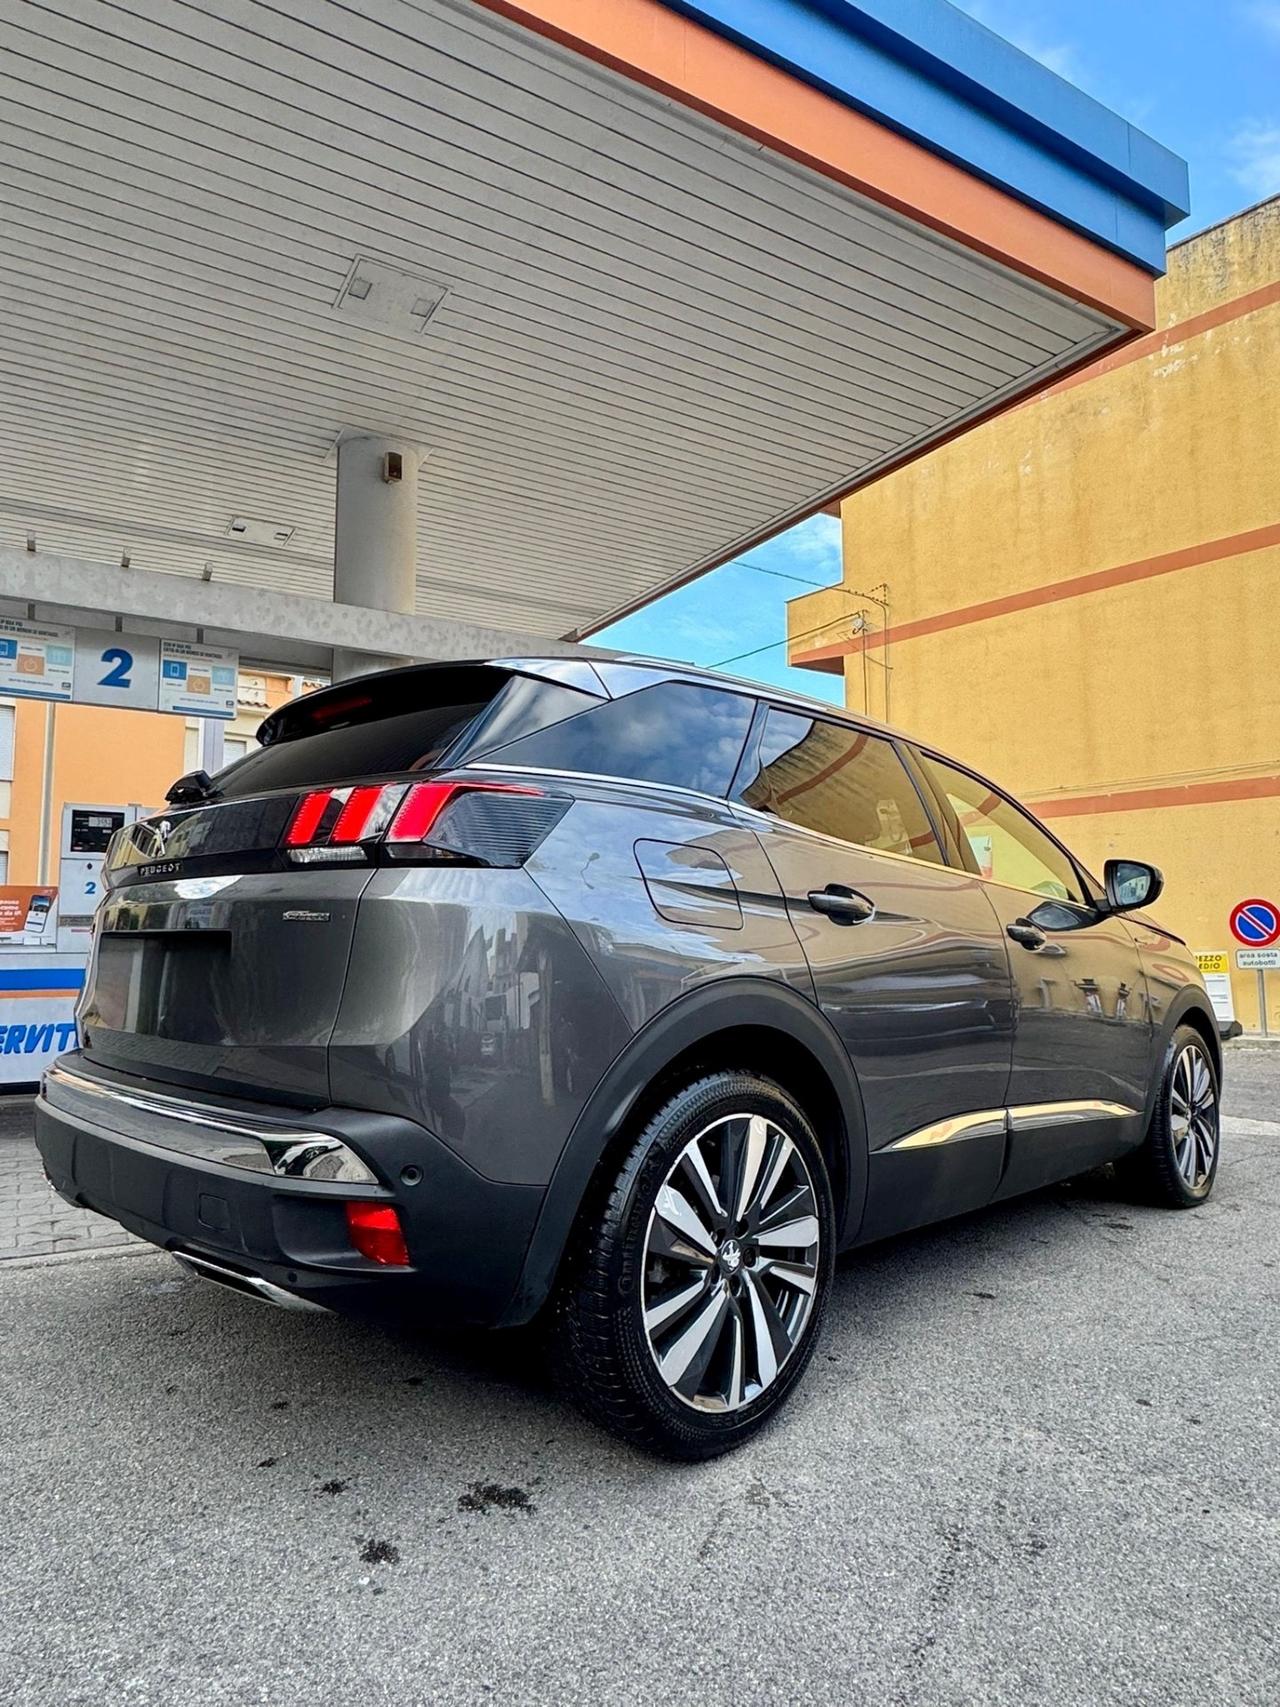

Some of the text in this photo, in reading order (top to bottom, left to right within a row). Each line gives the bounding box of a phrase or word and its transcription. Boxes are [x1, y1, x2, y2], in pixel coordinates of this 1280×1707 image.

[97, 648, 133, 688] 2
[140, 862, 180, 876] PEUGEOT
[84, 881, 97, 895] 2
[0, 1022, 79, 1054] ERVIT
